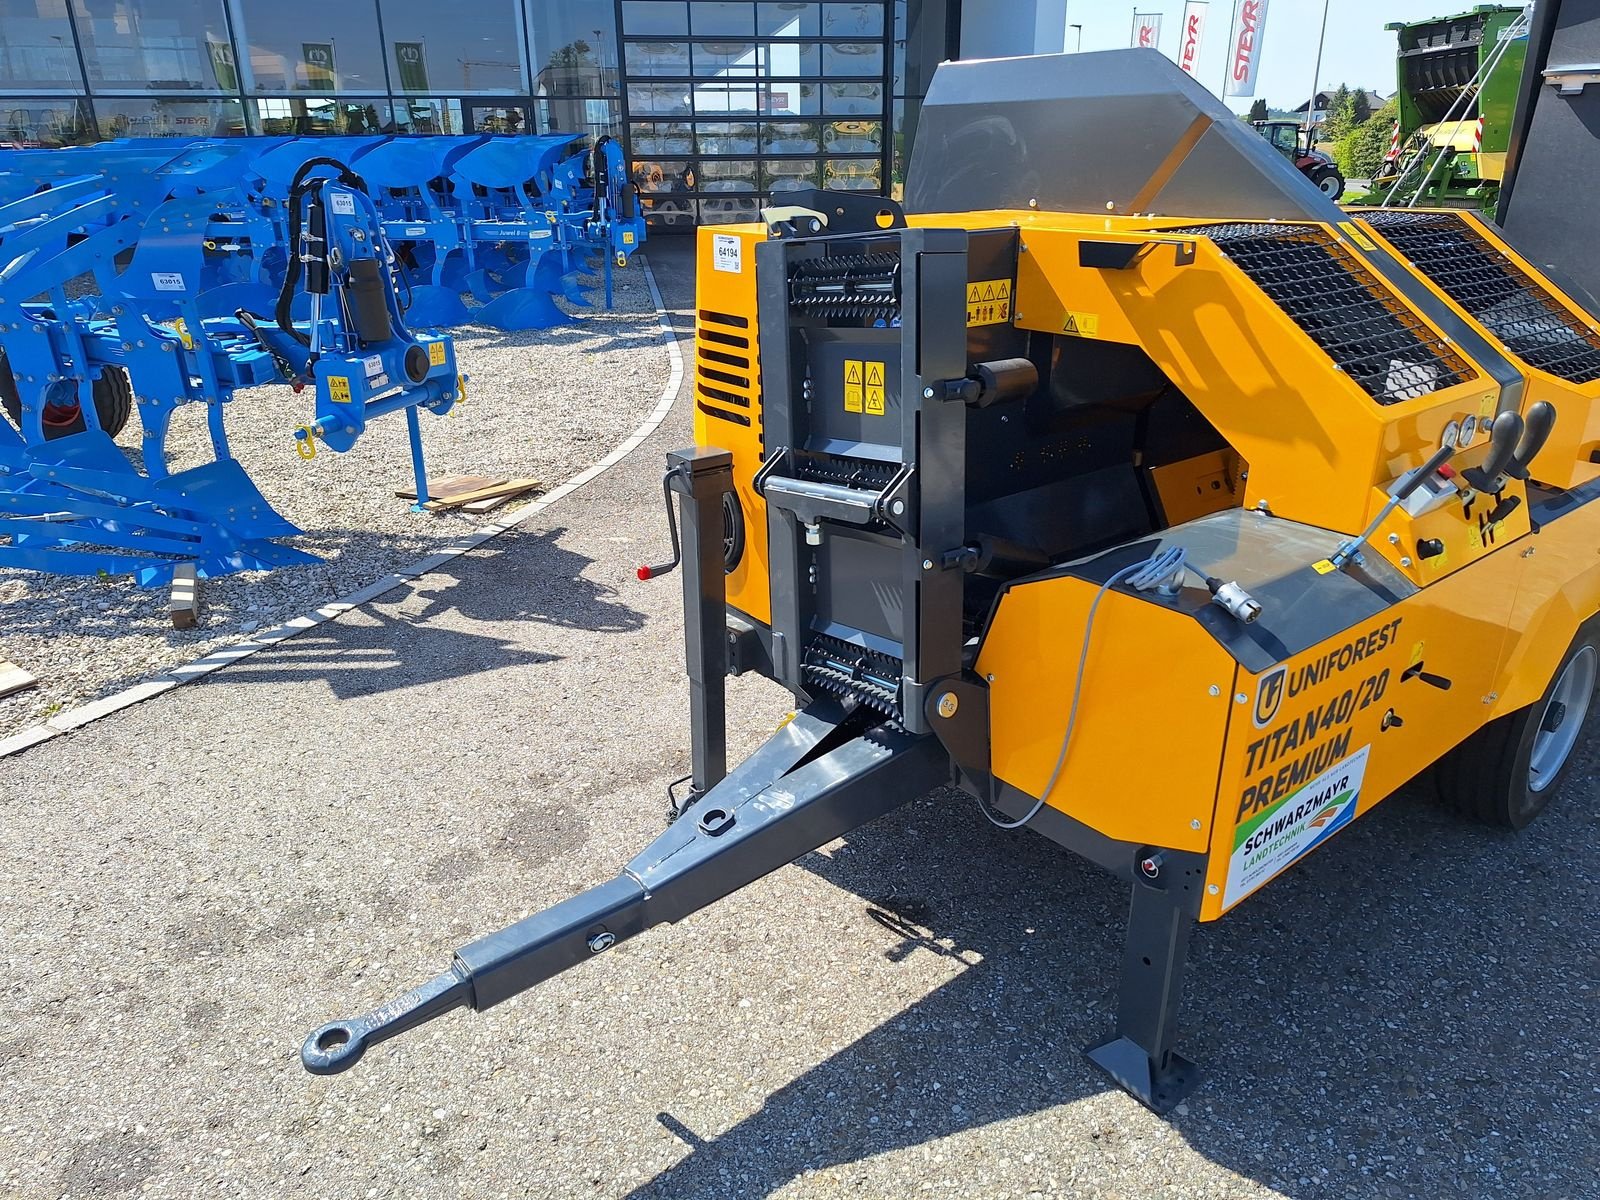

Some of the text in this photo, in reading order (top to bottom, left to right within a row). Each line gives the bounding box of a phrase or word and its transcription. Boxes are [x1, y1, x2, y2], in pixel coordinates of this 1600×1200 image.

[1182, 15, 1199, 71] TEYR
[1234, 0, 1259, 83] STEYR
[175, 117, 209, 125] STEYR
[719, 246, 738, 258] 64194
[1288, 617, 1402, 697] UNIFOREST
[1235, 727, 1352, 825] PREMIUM
[1243, 775, 1349, 856] SCHWARZMAYR
[1243, 822, 1306, 871] LANDTECHNIK
